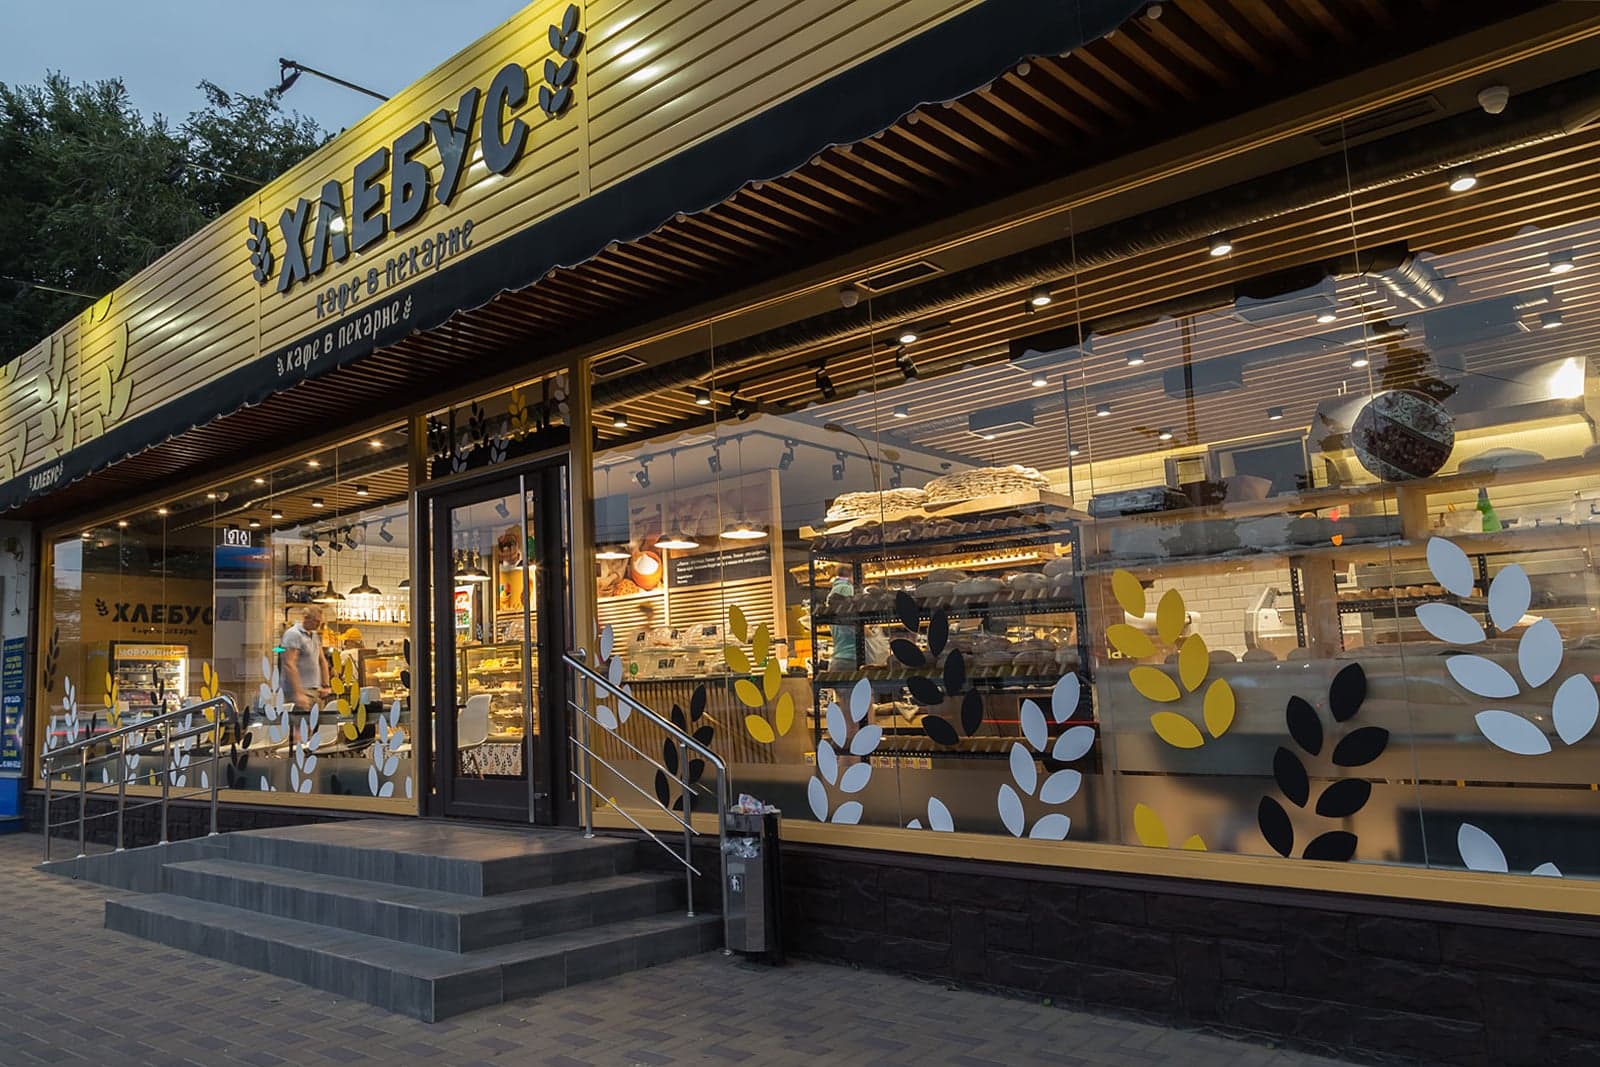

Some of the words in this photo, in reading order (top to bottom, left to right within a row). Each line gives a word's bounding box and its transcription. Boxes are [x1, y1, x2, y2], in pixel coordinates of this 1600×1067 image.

[277, 63, 530, 293] ХЛЕБУС
[316, 276, 360, 319] кафе
[367, 267, 379, 295] в
[386, 219, 474, 288] пекарне
[286, 338, 319, 371] кафе
[324, 332, 333, 354] в
[338, 301, 400, 349] пекарне
[112, 603, 214, 625] ХЛЕБУС
